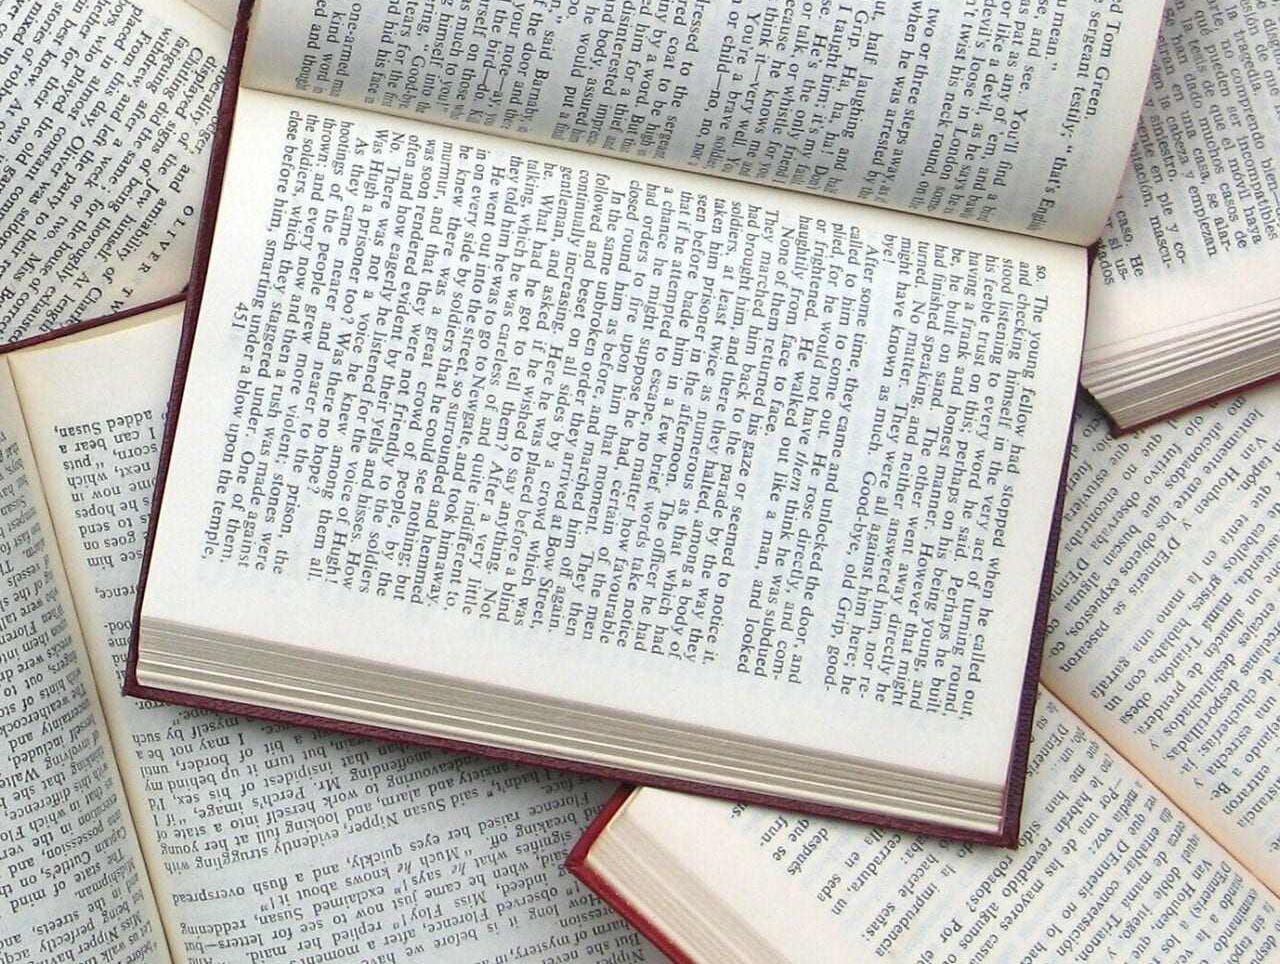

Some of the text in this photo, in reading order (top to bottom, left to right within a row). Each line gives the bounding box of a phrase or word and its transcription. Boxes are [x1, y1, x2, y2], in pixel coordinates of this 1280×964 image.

[1143, 97, 1155, 107] y
[1115, 209, 1145, 278] caso. He
[230, 301, 250, 329] 451
[763, 214, 813, 437] haughtily from face to face.
[1239, 436, 1268, 460] Van
[1193, 465, 1241, 515] Houben
[1181, 521, 1193, 531] y
[1111, 599, 1127, 616] se
[1058, 619, 1110, 673] pasearon
[171, 791, 589, 908] Florence raised her eyes quickly, and a flush overspread
[830, 833, 901, 916] cerradura, un
[897, 853, 940, 898] hacerle
